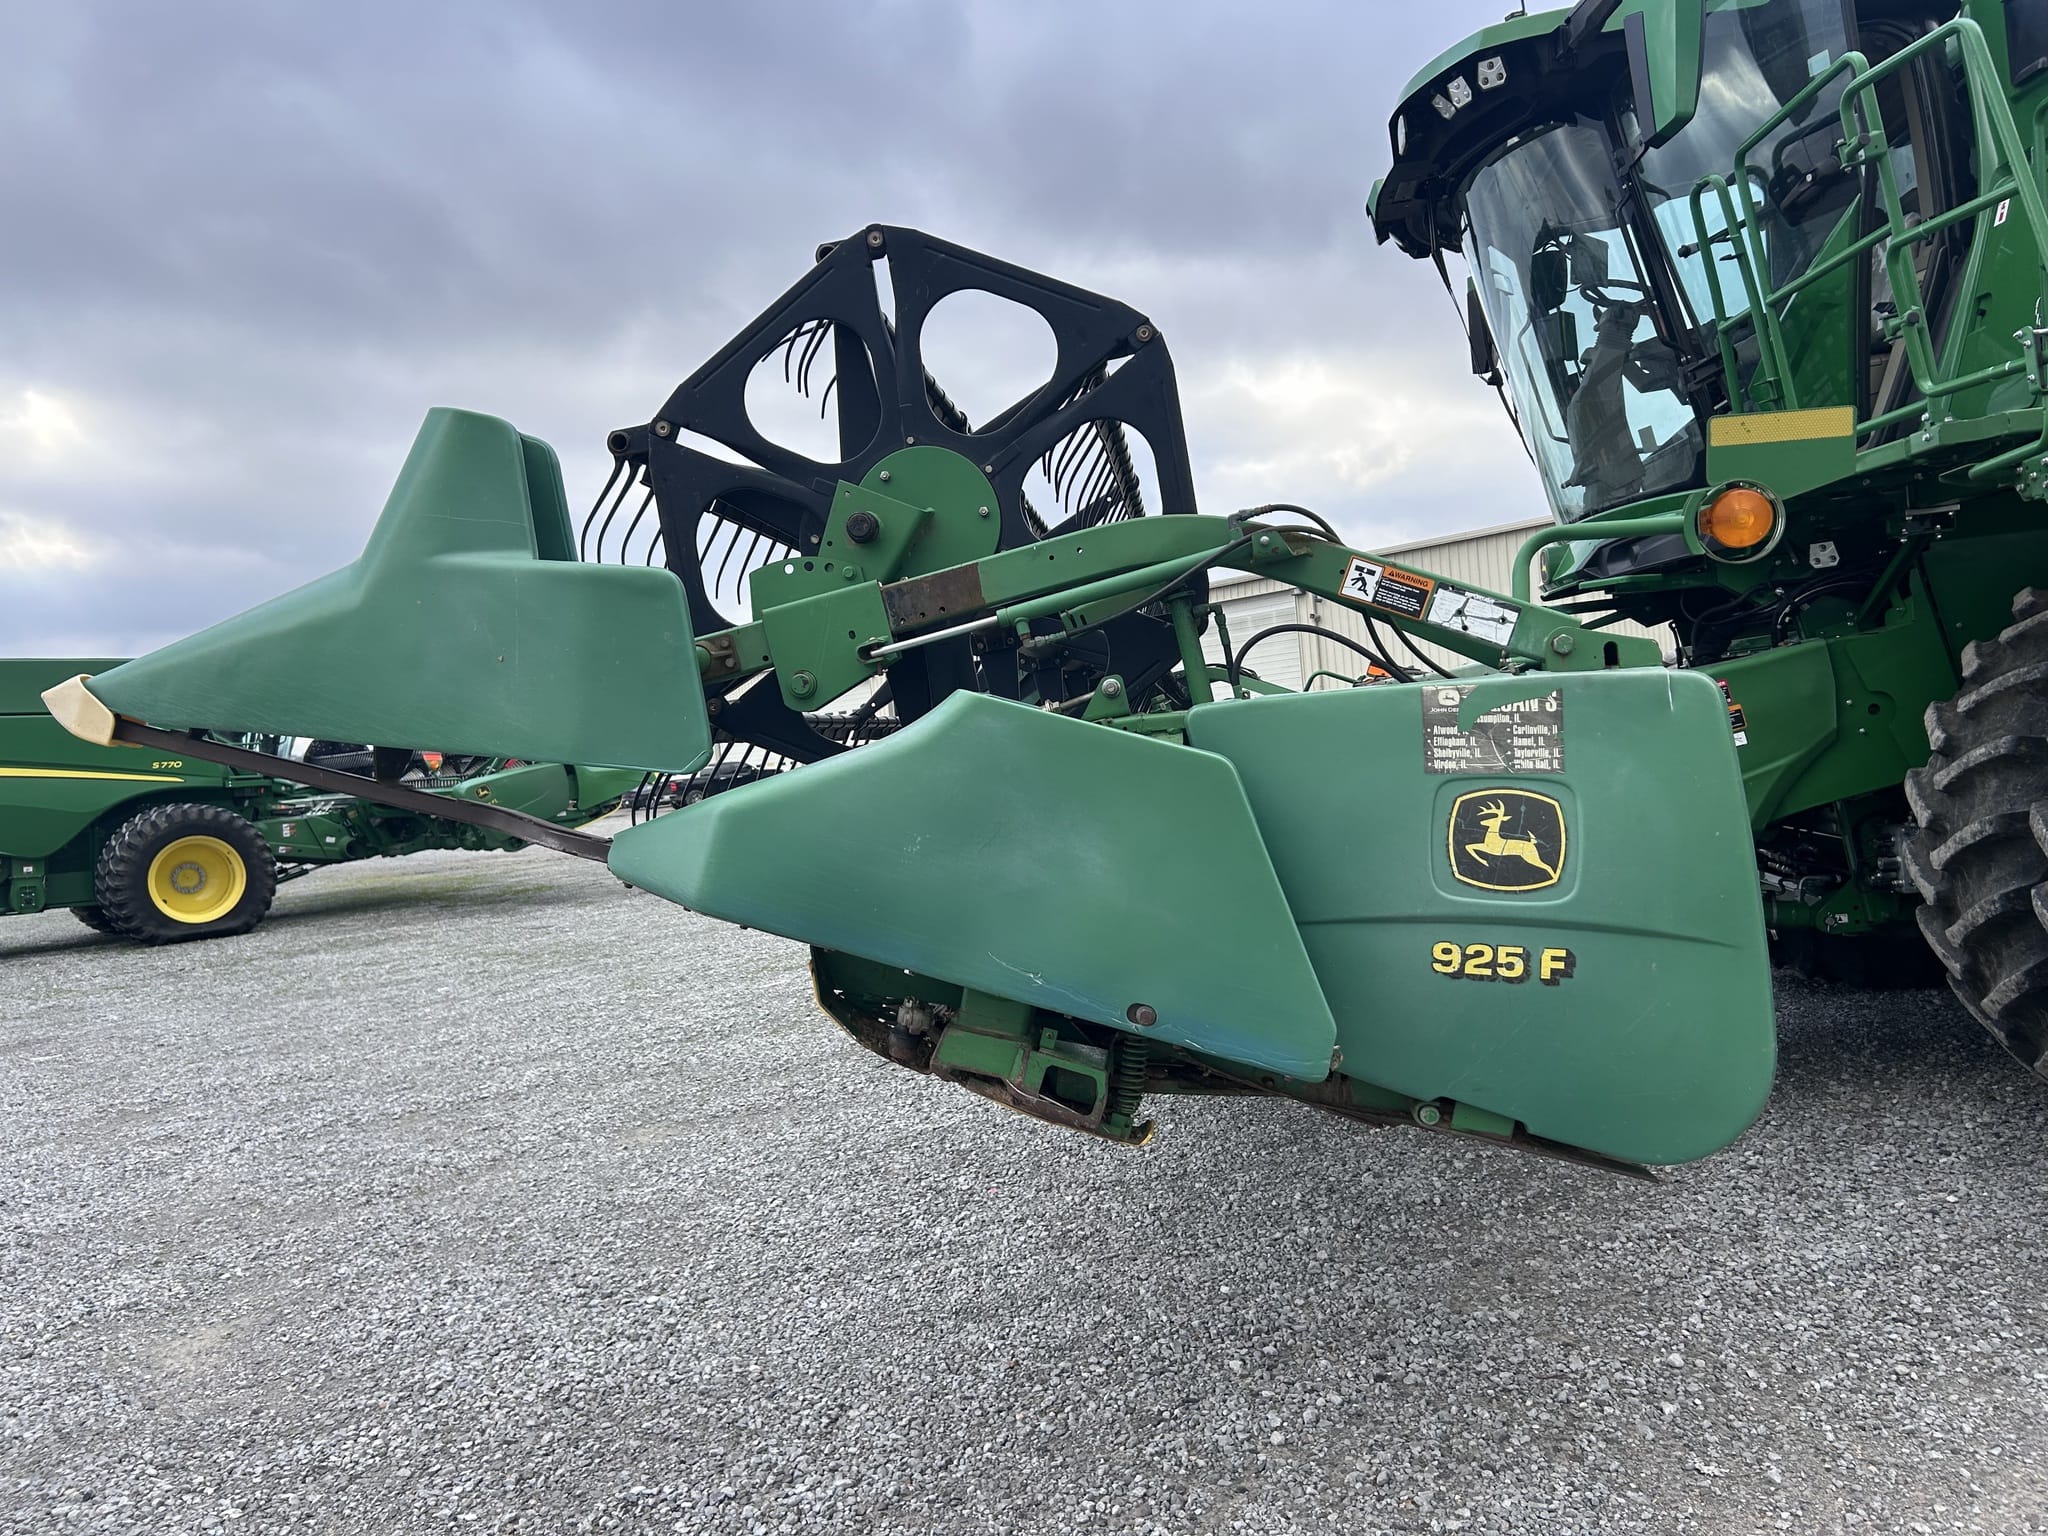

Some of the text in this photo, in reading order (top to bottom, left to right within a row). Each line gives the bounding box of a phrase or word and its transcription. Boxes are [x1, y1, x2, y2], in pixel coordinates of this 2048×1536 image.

[1394, 571, 1429, 588] WARNING
[1514, 713, 1521, 723] IL
[1433, 725, 1460, 737] Atwood,
[1513, 725, 1550, 737] Carlinville,
[1433, 736, 1478, 748] Effingham, IL
[1513, 736, 1545, 748] Hamel, IL
[1433, 748, 1482, 760] Shelbyville, IL
[1514, 748, 1560, 759] Taylorville, IL
[1433, 759, 1468, 771] Virden, IL
[1535, 759, 1551, 770] Hall,
[1553, 759, 1560, 769] IL
[1432, 941, 1571, 983] 925 F
